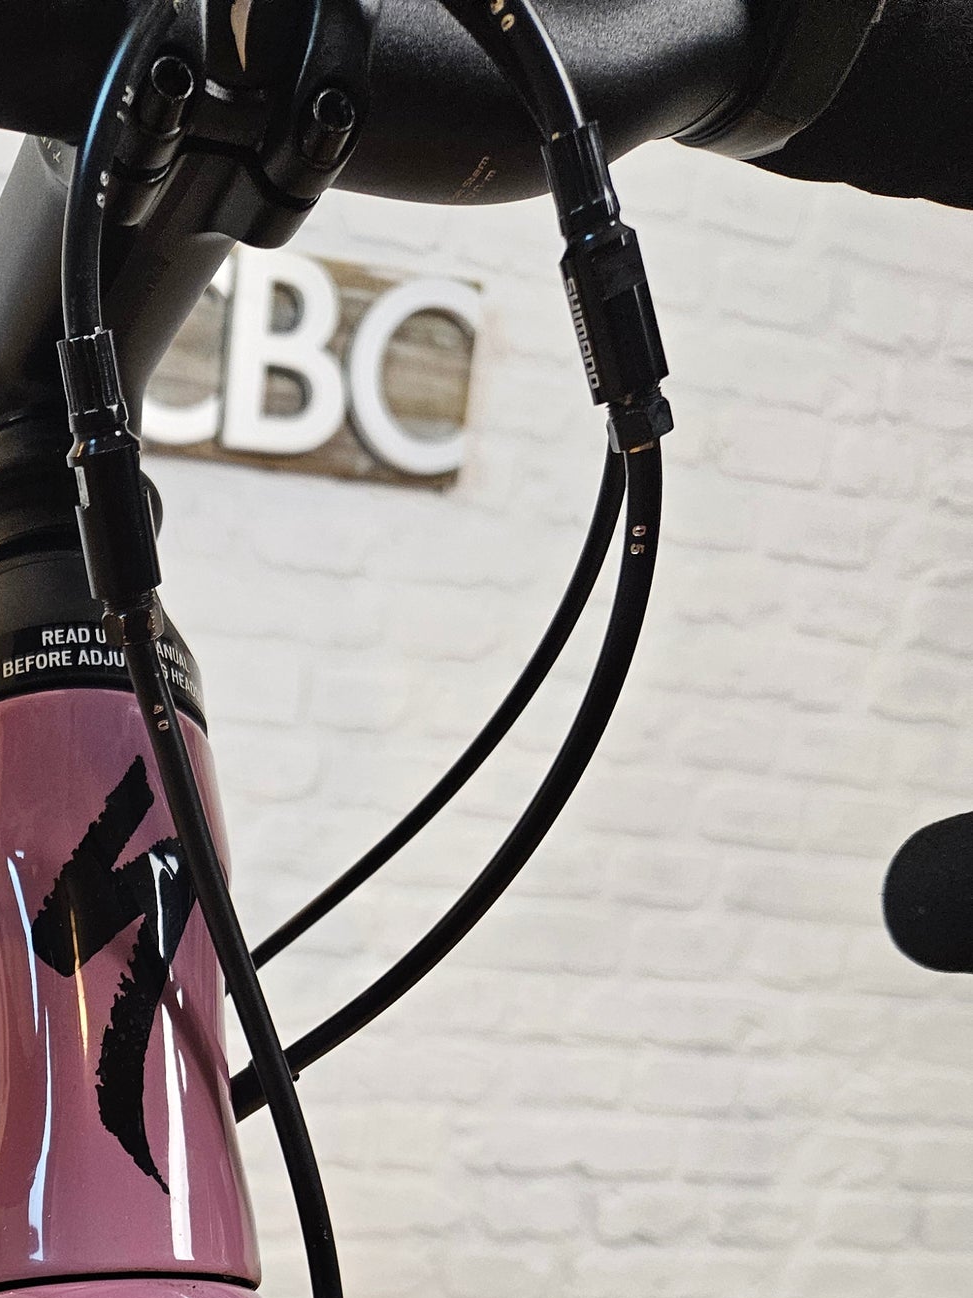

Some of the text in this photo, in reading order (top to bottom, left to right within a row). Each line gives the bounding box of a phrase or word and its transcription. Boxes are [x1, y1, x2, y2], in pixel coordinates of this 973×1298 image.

[566, 278, 600, 390] SHIMANO
[2, 650, 73, 678] BEFORE
[77, 650, 125, 668] ADJU
[41, 627, 190, 673] READ U ANUAL
